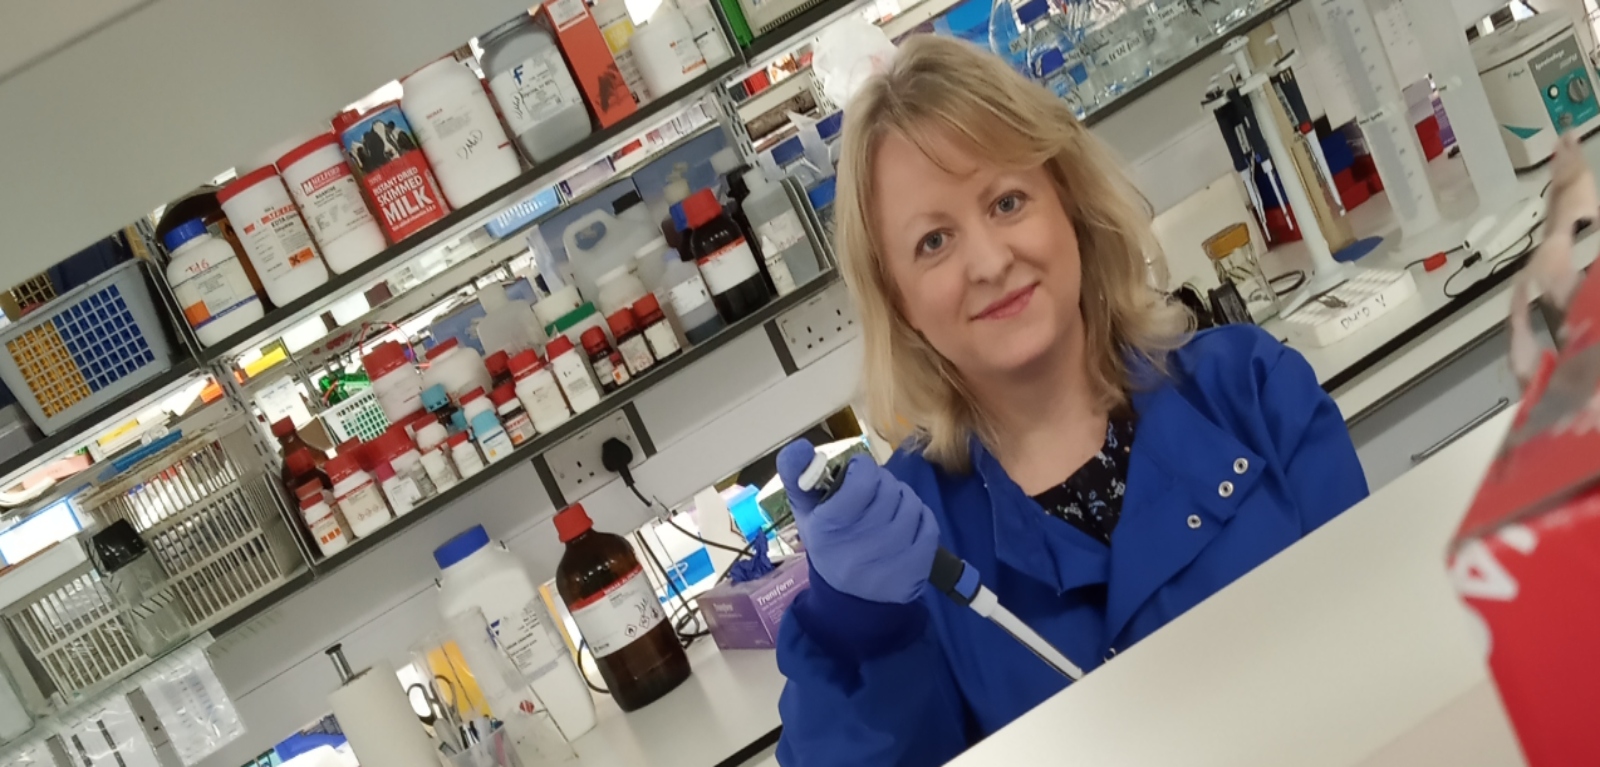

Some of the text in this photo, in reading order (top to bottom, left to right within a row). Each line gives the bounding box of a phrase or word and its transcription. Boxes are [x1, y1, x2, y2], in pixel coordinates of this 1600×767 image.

[373, 176, 398, 196] INSTANT
[397, 166, 418, 181] DRIED
[377, 174, 423, 207] SKIMMED
[382, 185, 434, 226] MILK
[757, 578, 795, 606] Transform
